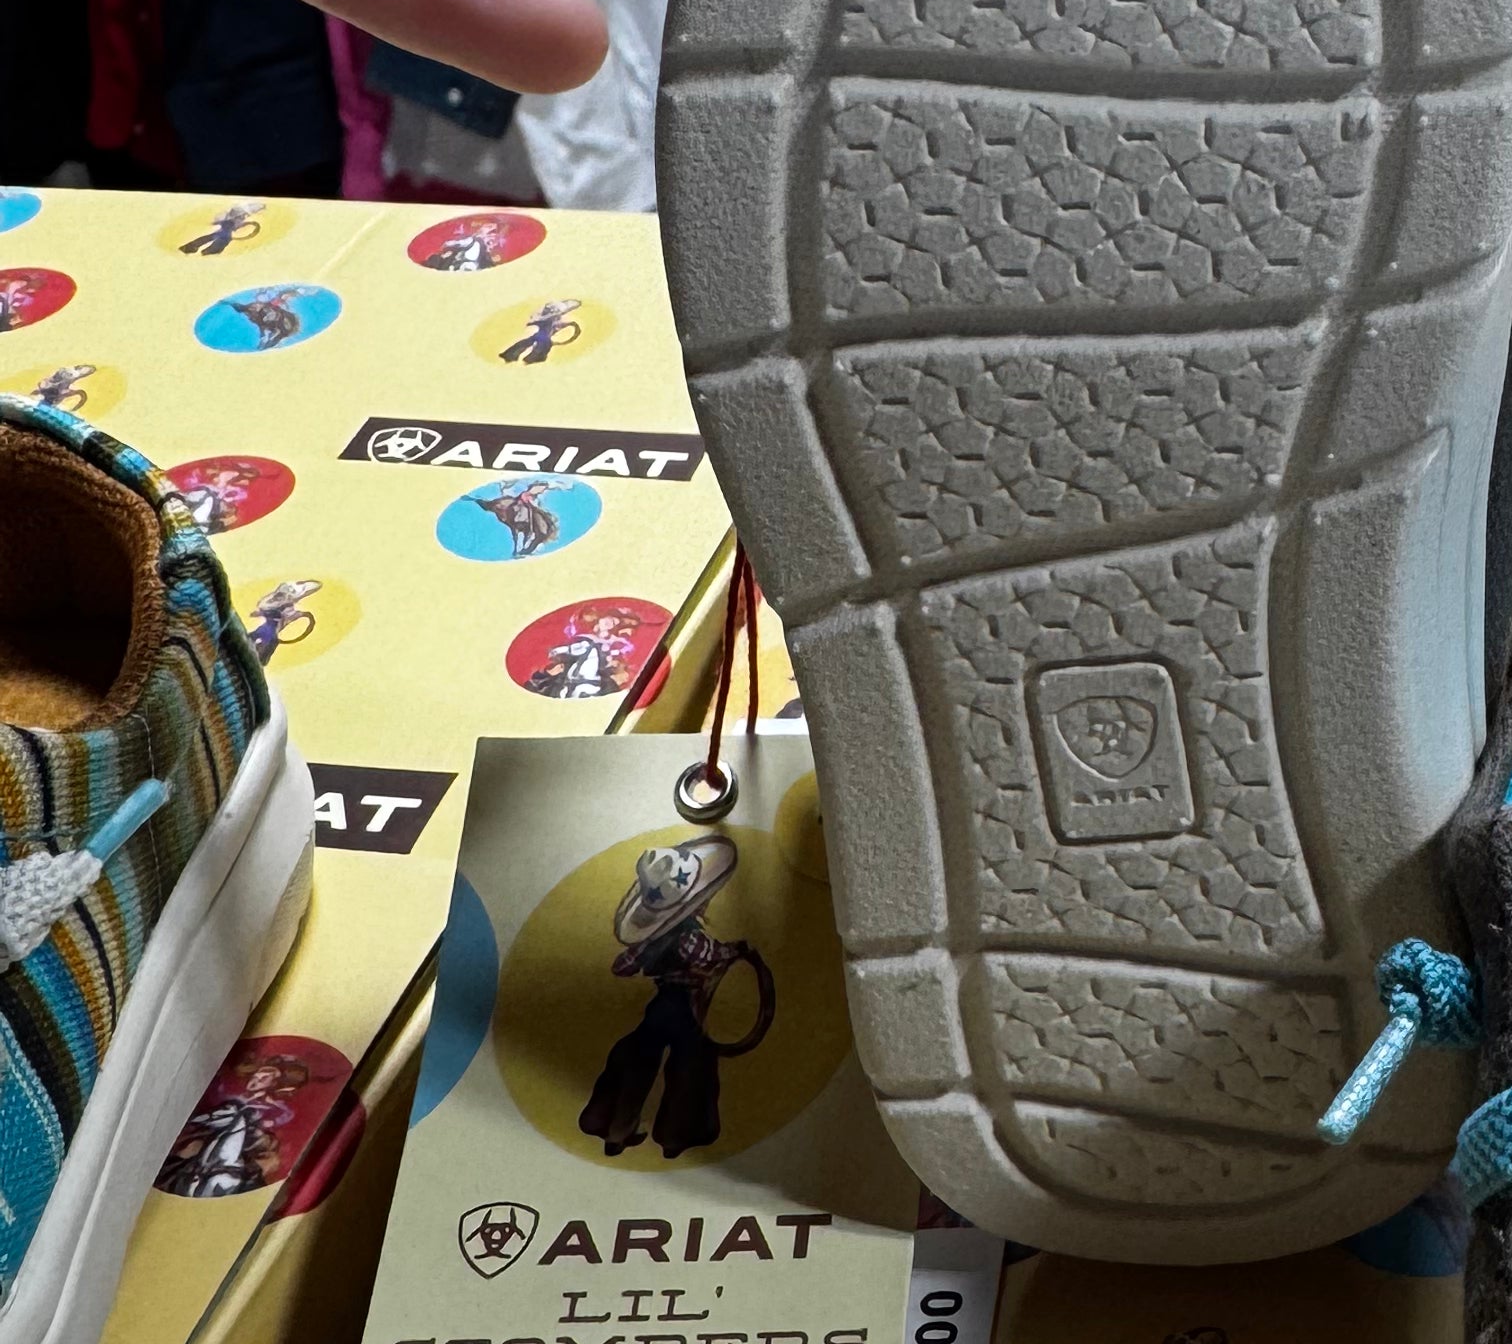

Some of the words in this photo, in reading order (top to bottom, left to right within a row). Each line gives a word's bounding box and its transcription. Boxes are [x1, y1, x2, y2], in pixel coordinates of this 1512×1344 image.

[430, 440, 690, 478] ARIAT
[537, 1213, 833, 1266] ARIAT
[558, 1286, 724, 1324] LIL'
